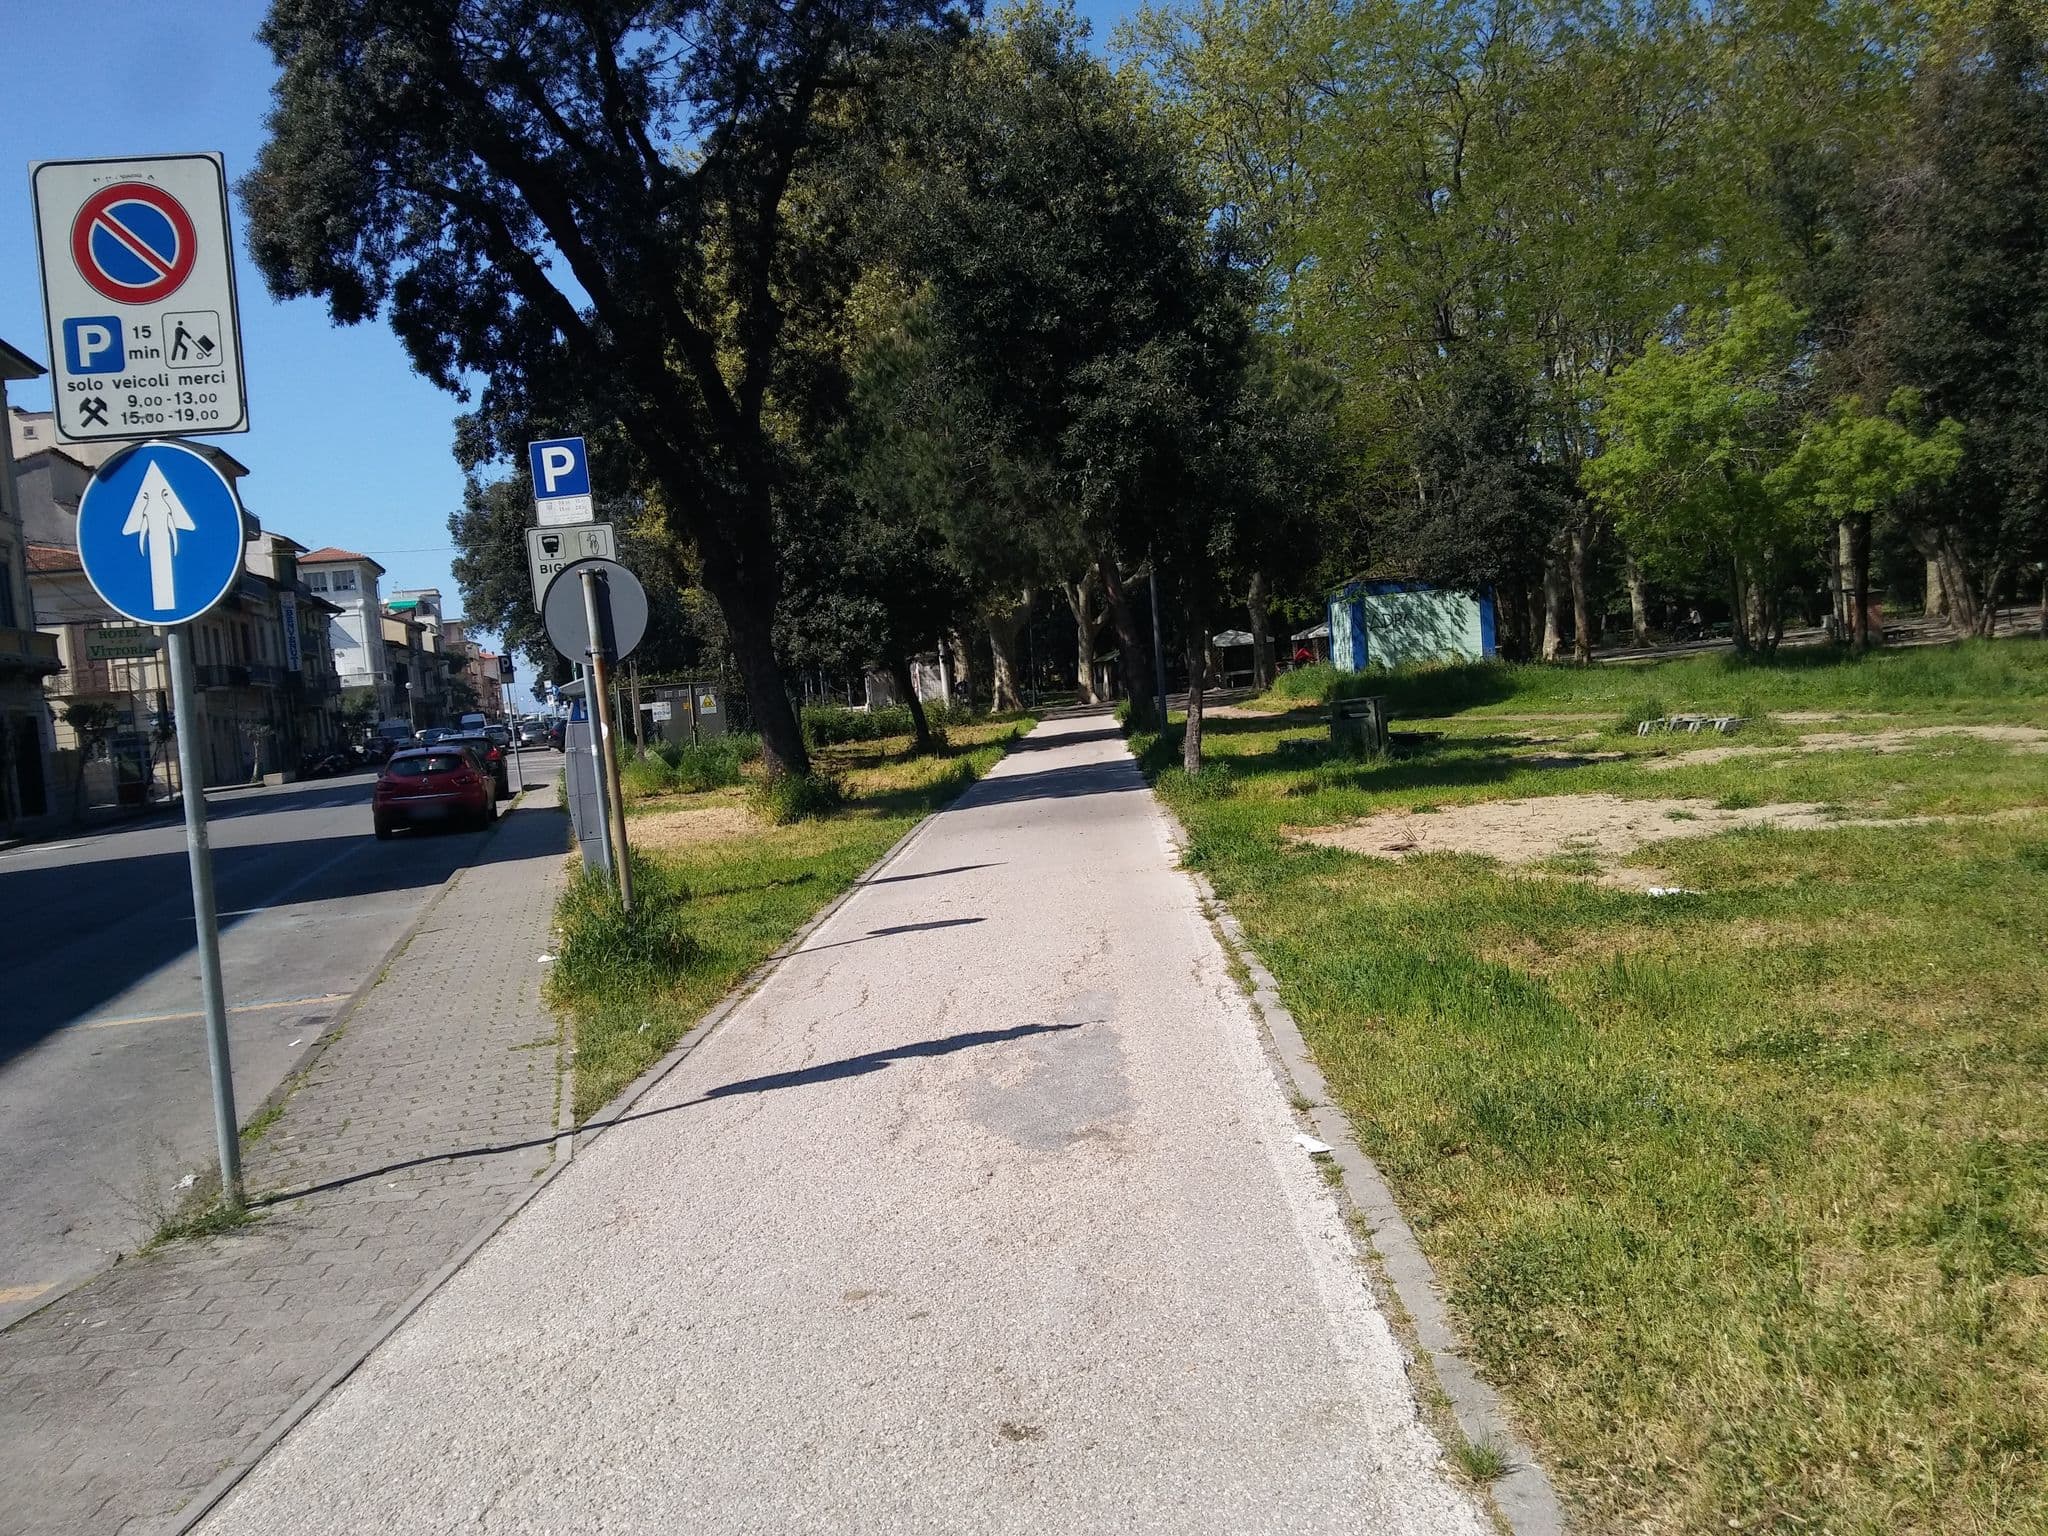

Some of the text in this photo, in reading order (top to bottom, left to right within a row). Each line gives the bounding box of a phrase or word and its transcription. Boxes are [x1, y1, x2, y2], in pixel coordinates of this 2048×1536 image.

[133, 326, 152, 339] 15
[77, 324, 111, 367] P
[128, 346, 160, 360] min
[67, 370, 225, 392] solo veicoli merci
[541, 446, 575, 492] P
[540, 562, 567, 574] BIG
[98, 629, 141, 639] HOTEL
[502, 657, 510, 672] P
